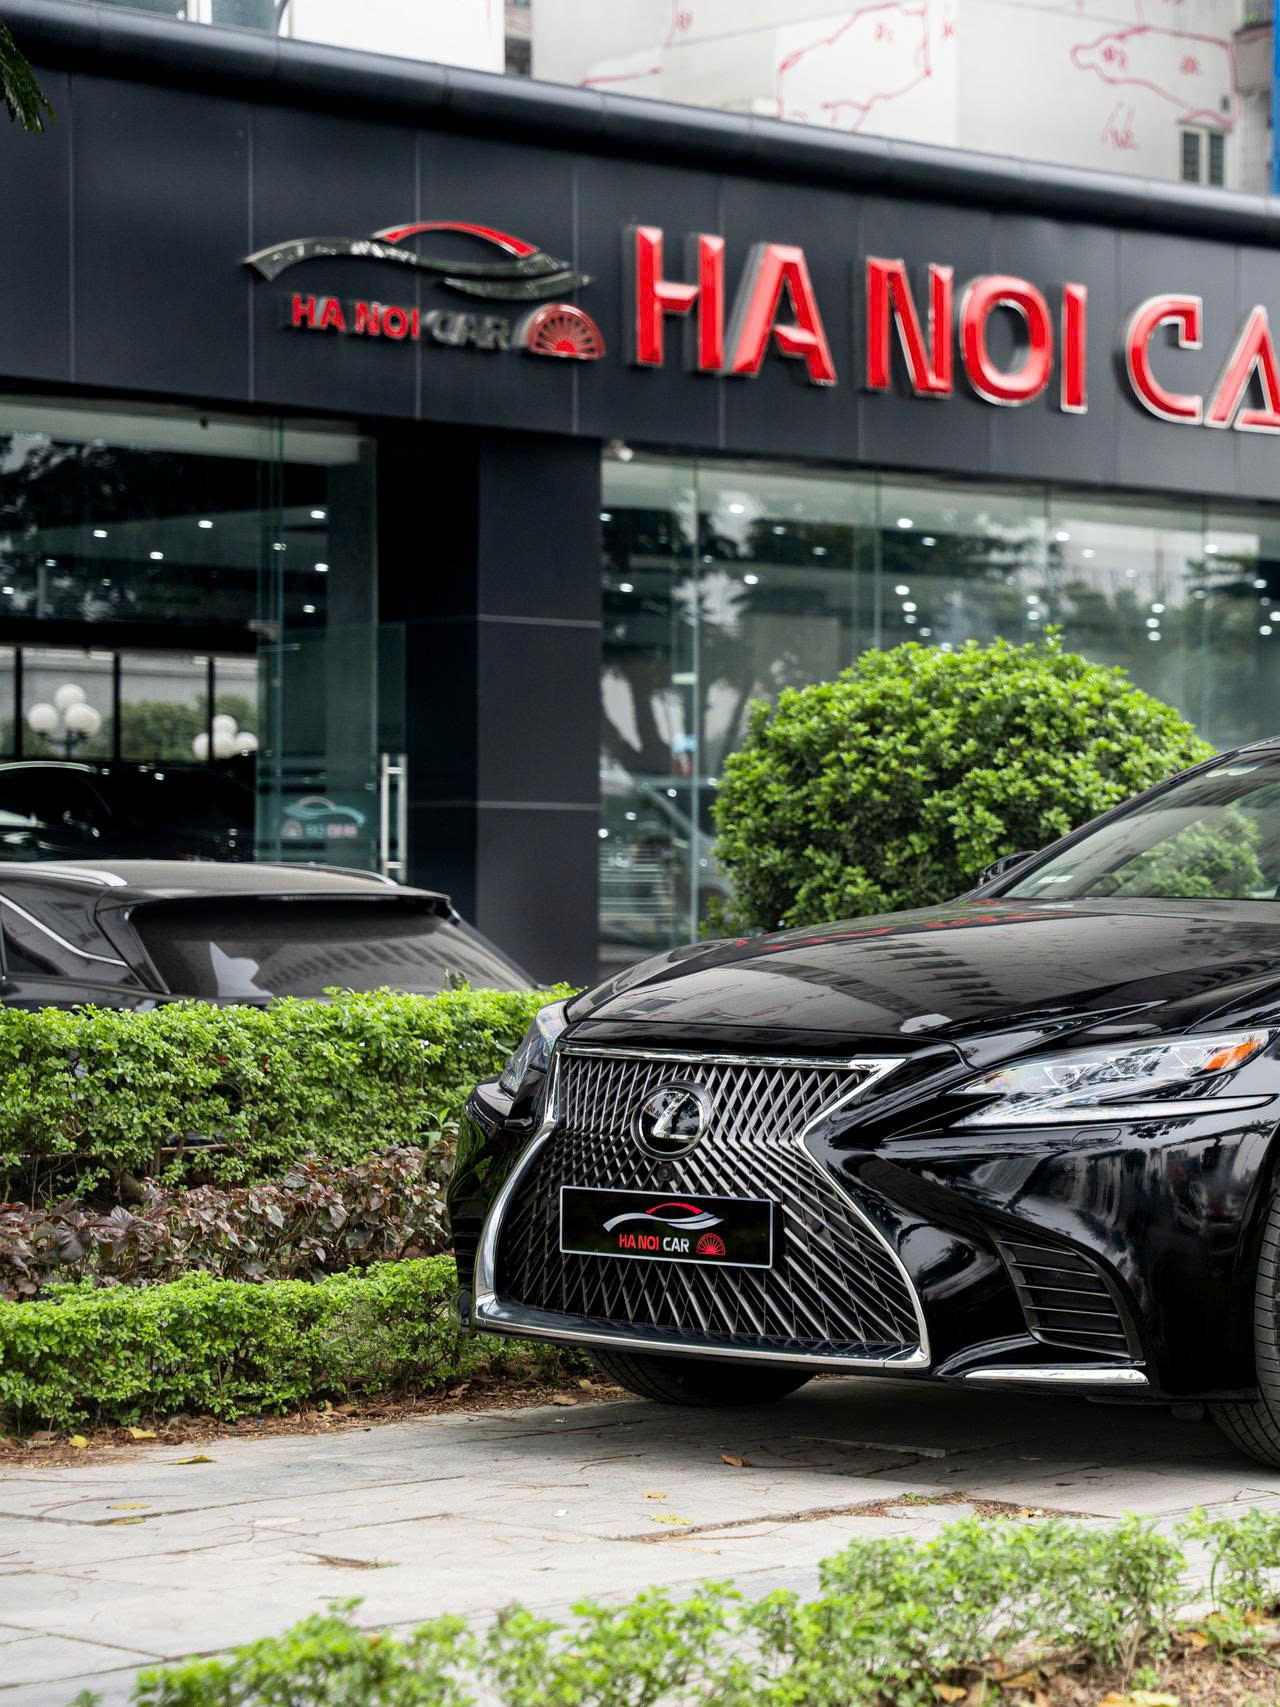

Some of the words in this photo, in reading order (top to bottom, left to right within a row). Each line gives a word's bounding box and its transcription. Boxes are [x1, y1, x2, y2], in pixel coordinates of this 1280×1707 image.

[292, 292, 347, 333] HA
[355, 301, 420, 341] NOI
[424, 308, 511, 351] CAR
[627, 225, 838, 388] HA
[865, 254, 1090, 415] NOI
[619, 1233, 637, 1249] HA
[638, 1234, 659, 1252] NOI
[662, 1236, 690, 1253] CAR
